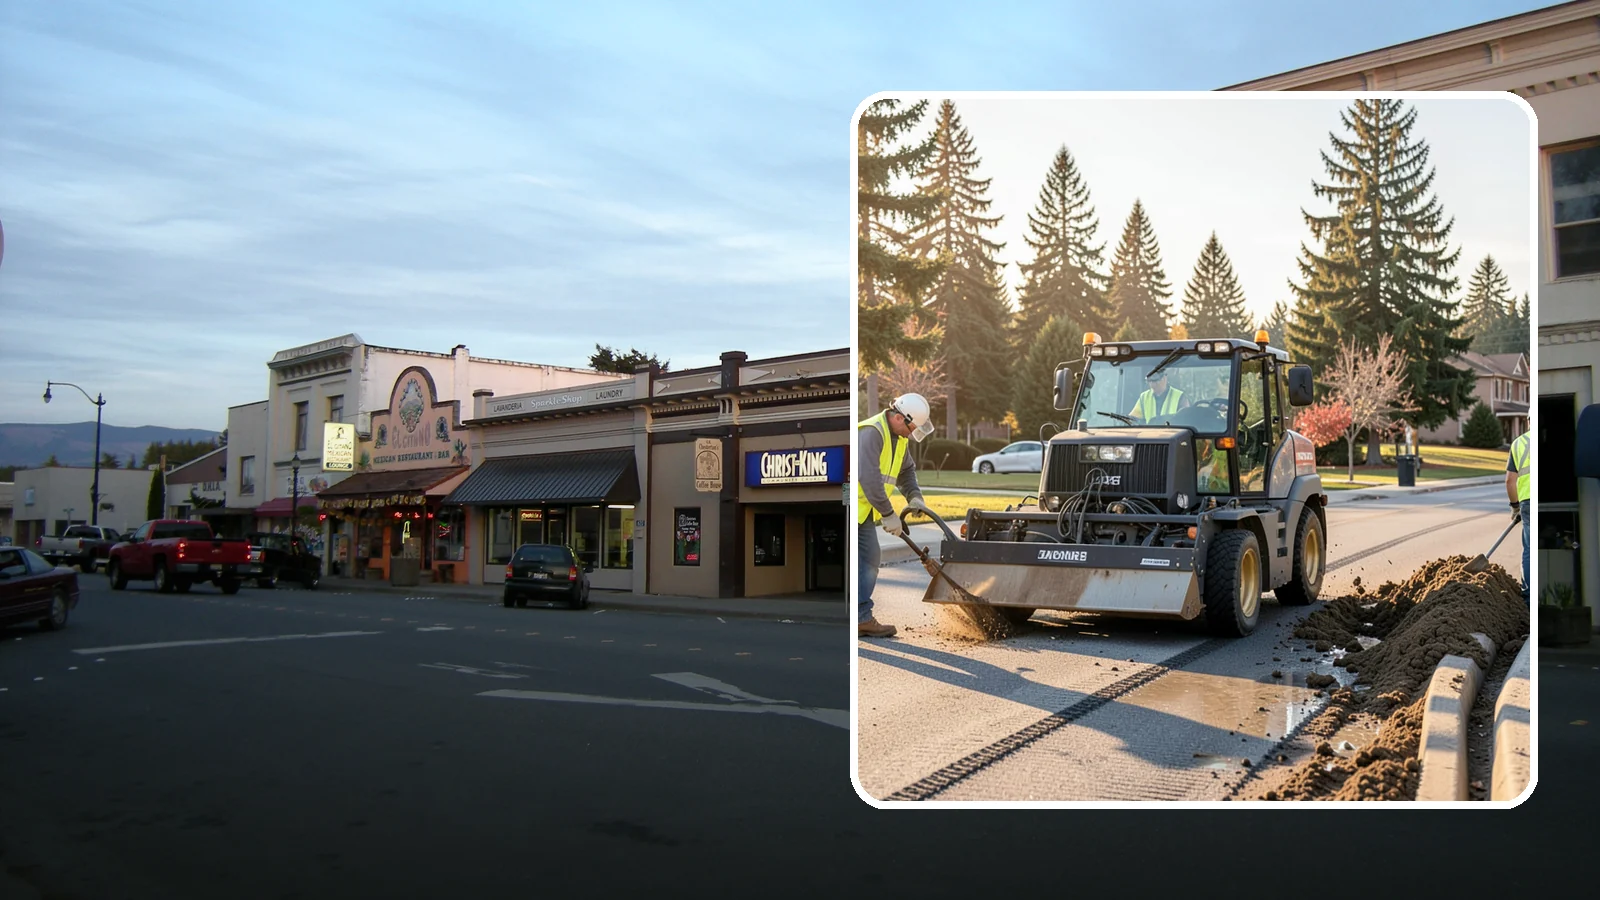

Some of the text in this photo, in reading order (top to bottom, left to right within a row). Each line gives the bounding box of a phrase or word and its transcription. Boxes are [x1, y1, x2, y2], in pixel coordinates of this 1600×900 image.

[595, 388, 623, 400] LAUNDRY
[493, 402, 522, 412] LAVANDERIA
[373, 450, 450, 464] MEXICAN RESTAURANT BAR
[761, 450, 828, 478] CHRIST KING
[696, 480, 709, 489] Coffee
